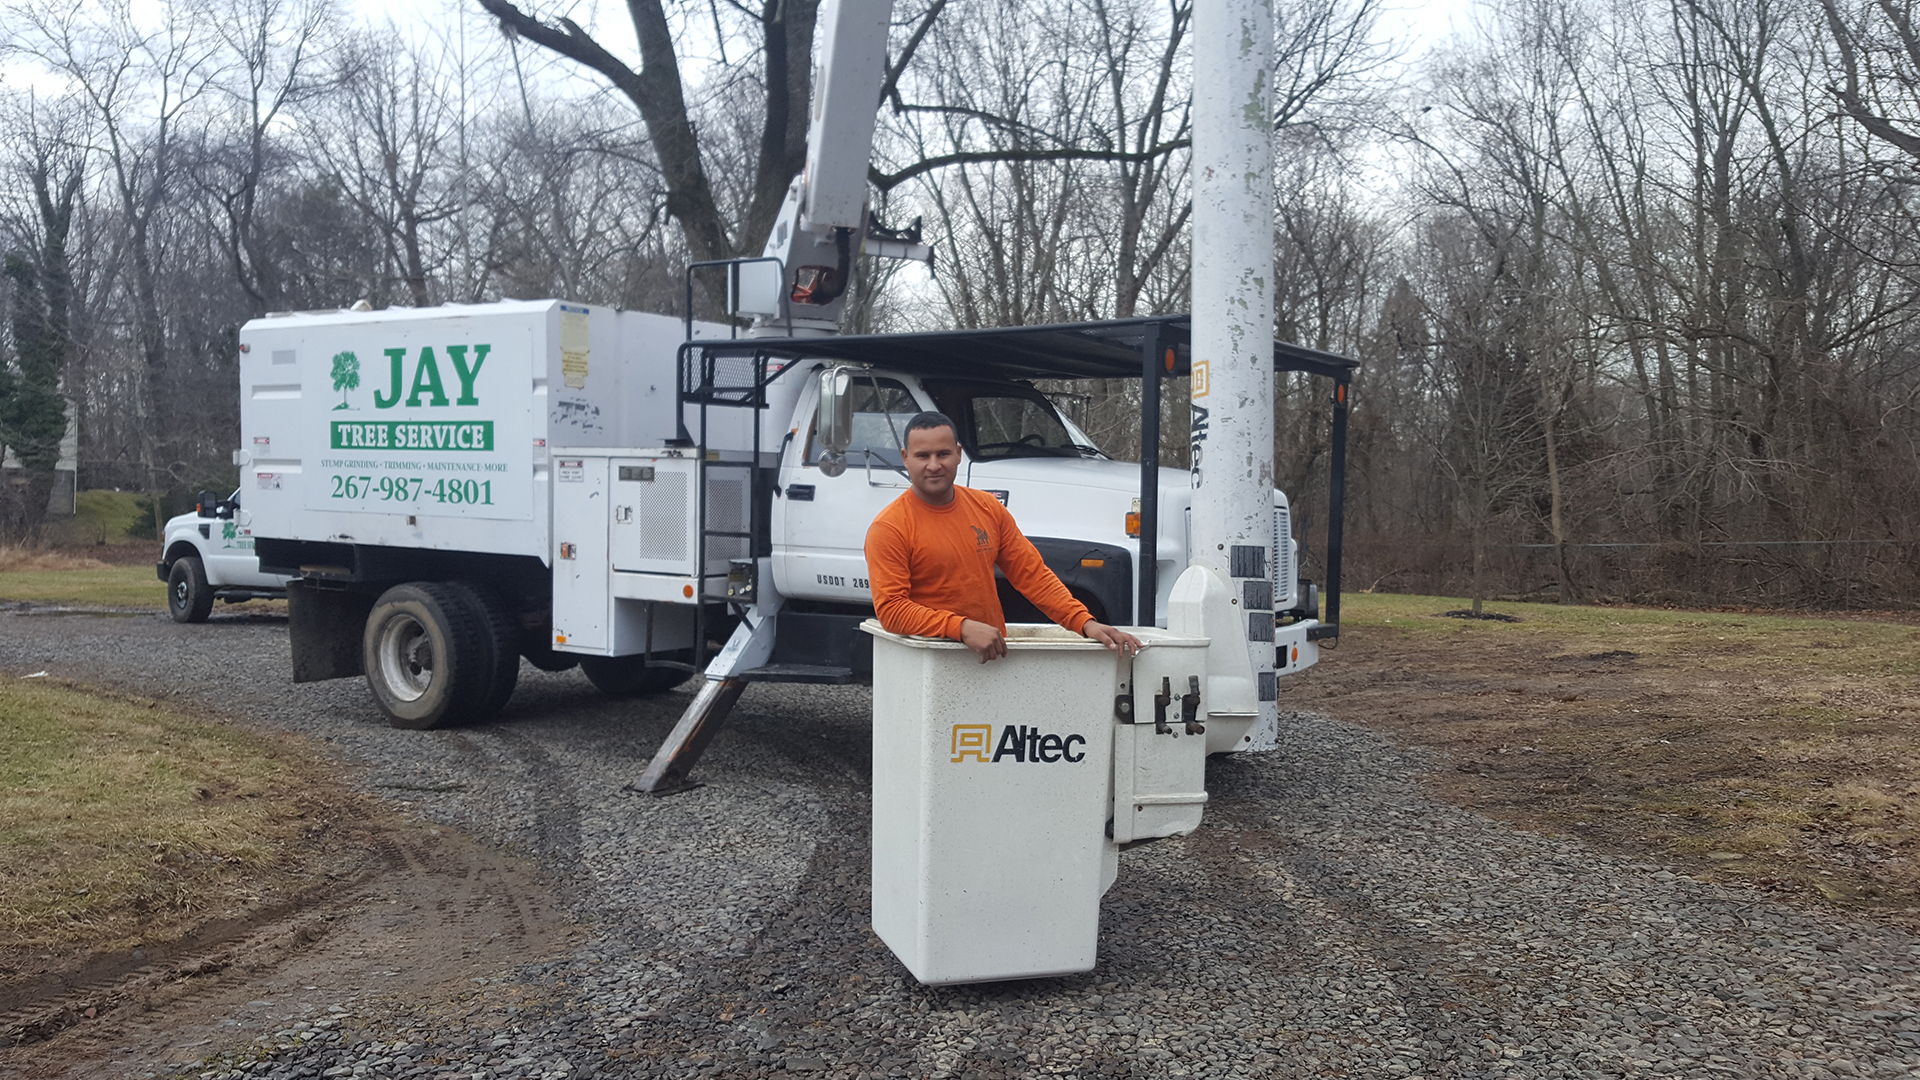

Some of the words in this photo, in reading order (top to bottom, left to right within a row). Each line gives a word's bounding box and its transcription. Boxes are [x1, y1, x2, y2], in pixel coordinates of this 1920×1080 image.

[373, 344, 491, 409] JAY
[338, 424, 389, 447] TREE
[395, 424, 485, 449] SERVICE
[1191, 403, 1209, 490] Altec
[320, 459, 344, 468] STUMP
[344, 460, 379, 469] GRINDING
[384, 461, 422, 470] TRIMMING
[427, 462, 482, 472] MAINTENANCE
[484, 463, 509, 472] MORE
[331, 475, 495, 505] 267-987-4801
[817, 574, 845, 587] USDOT
[853, 578, 870, 589] 289
[991, 725, 1087, 763] Altec
